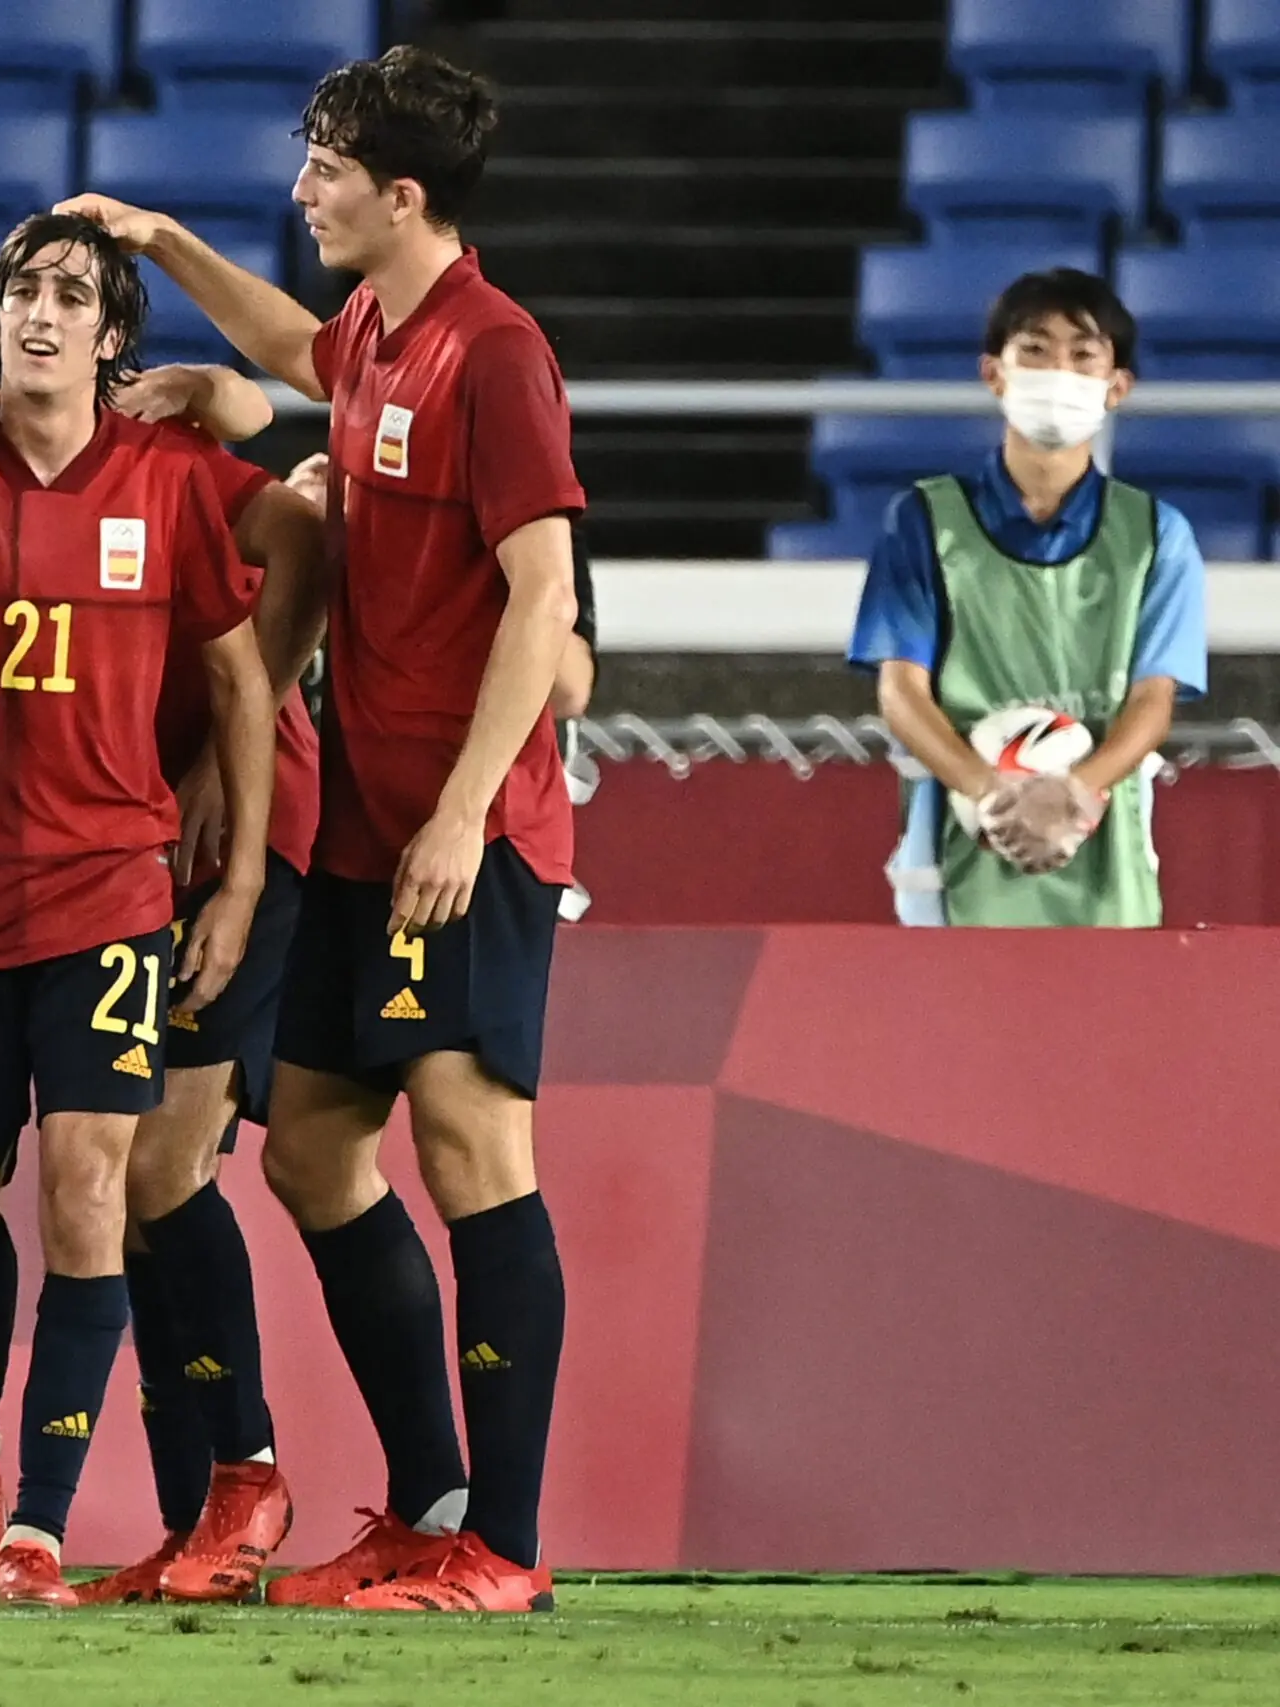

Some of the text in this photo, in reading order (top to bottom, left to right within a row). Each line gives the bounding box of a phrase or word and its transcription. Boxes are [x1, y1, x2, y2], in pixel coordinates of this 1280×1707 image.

[0, 600, 76, 692] 21
[91, 943, 160, 1046] 21
[379, 1007, 426, 1019] adidas
